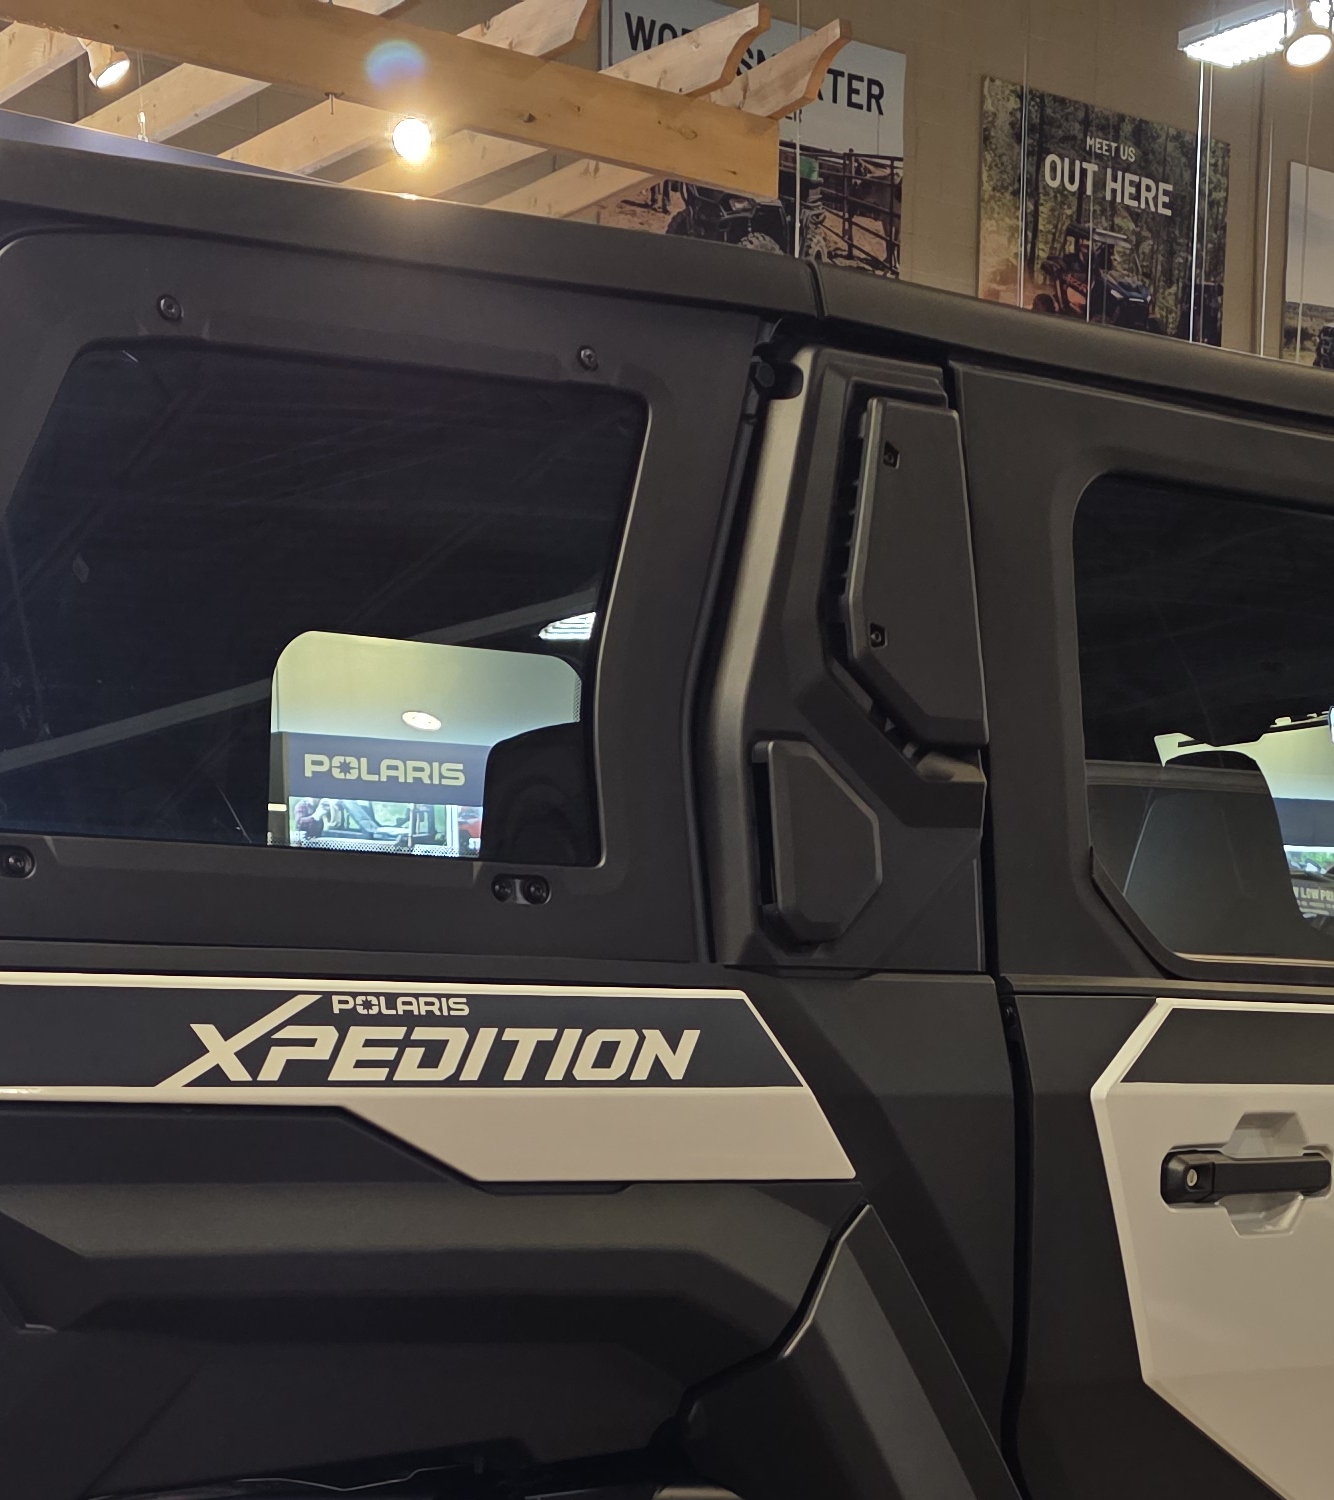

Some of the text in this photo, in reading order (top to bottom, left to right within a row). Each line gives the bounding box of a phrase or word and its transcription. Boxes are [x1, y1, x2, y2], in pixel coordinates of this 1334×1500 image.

[625, 12, 701, 51] WO
[1086, 136, 1136, 162] MEET US
[1044, 154, 1173, 217] OUT HERE
[304, 753, 465, 786] POLARIS
[332, 995, 469, 1016] POLARIS
[155, 994, 701, 1088] XPEDITION
